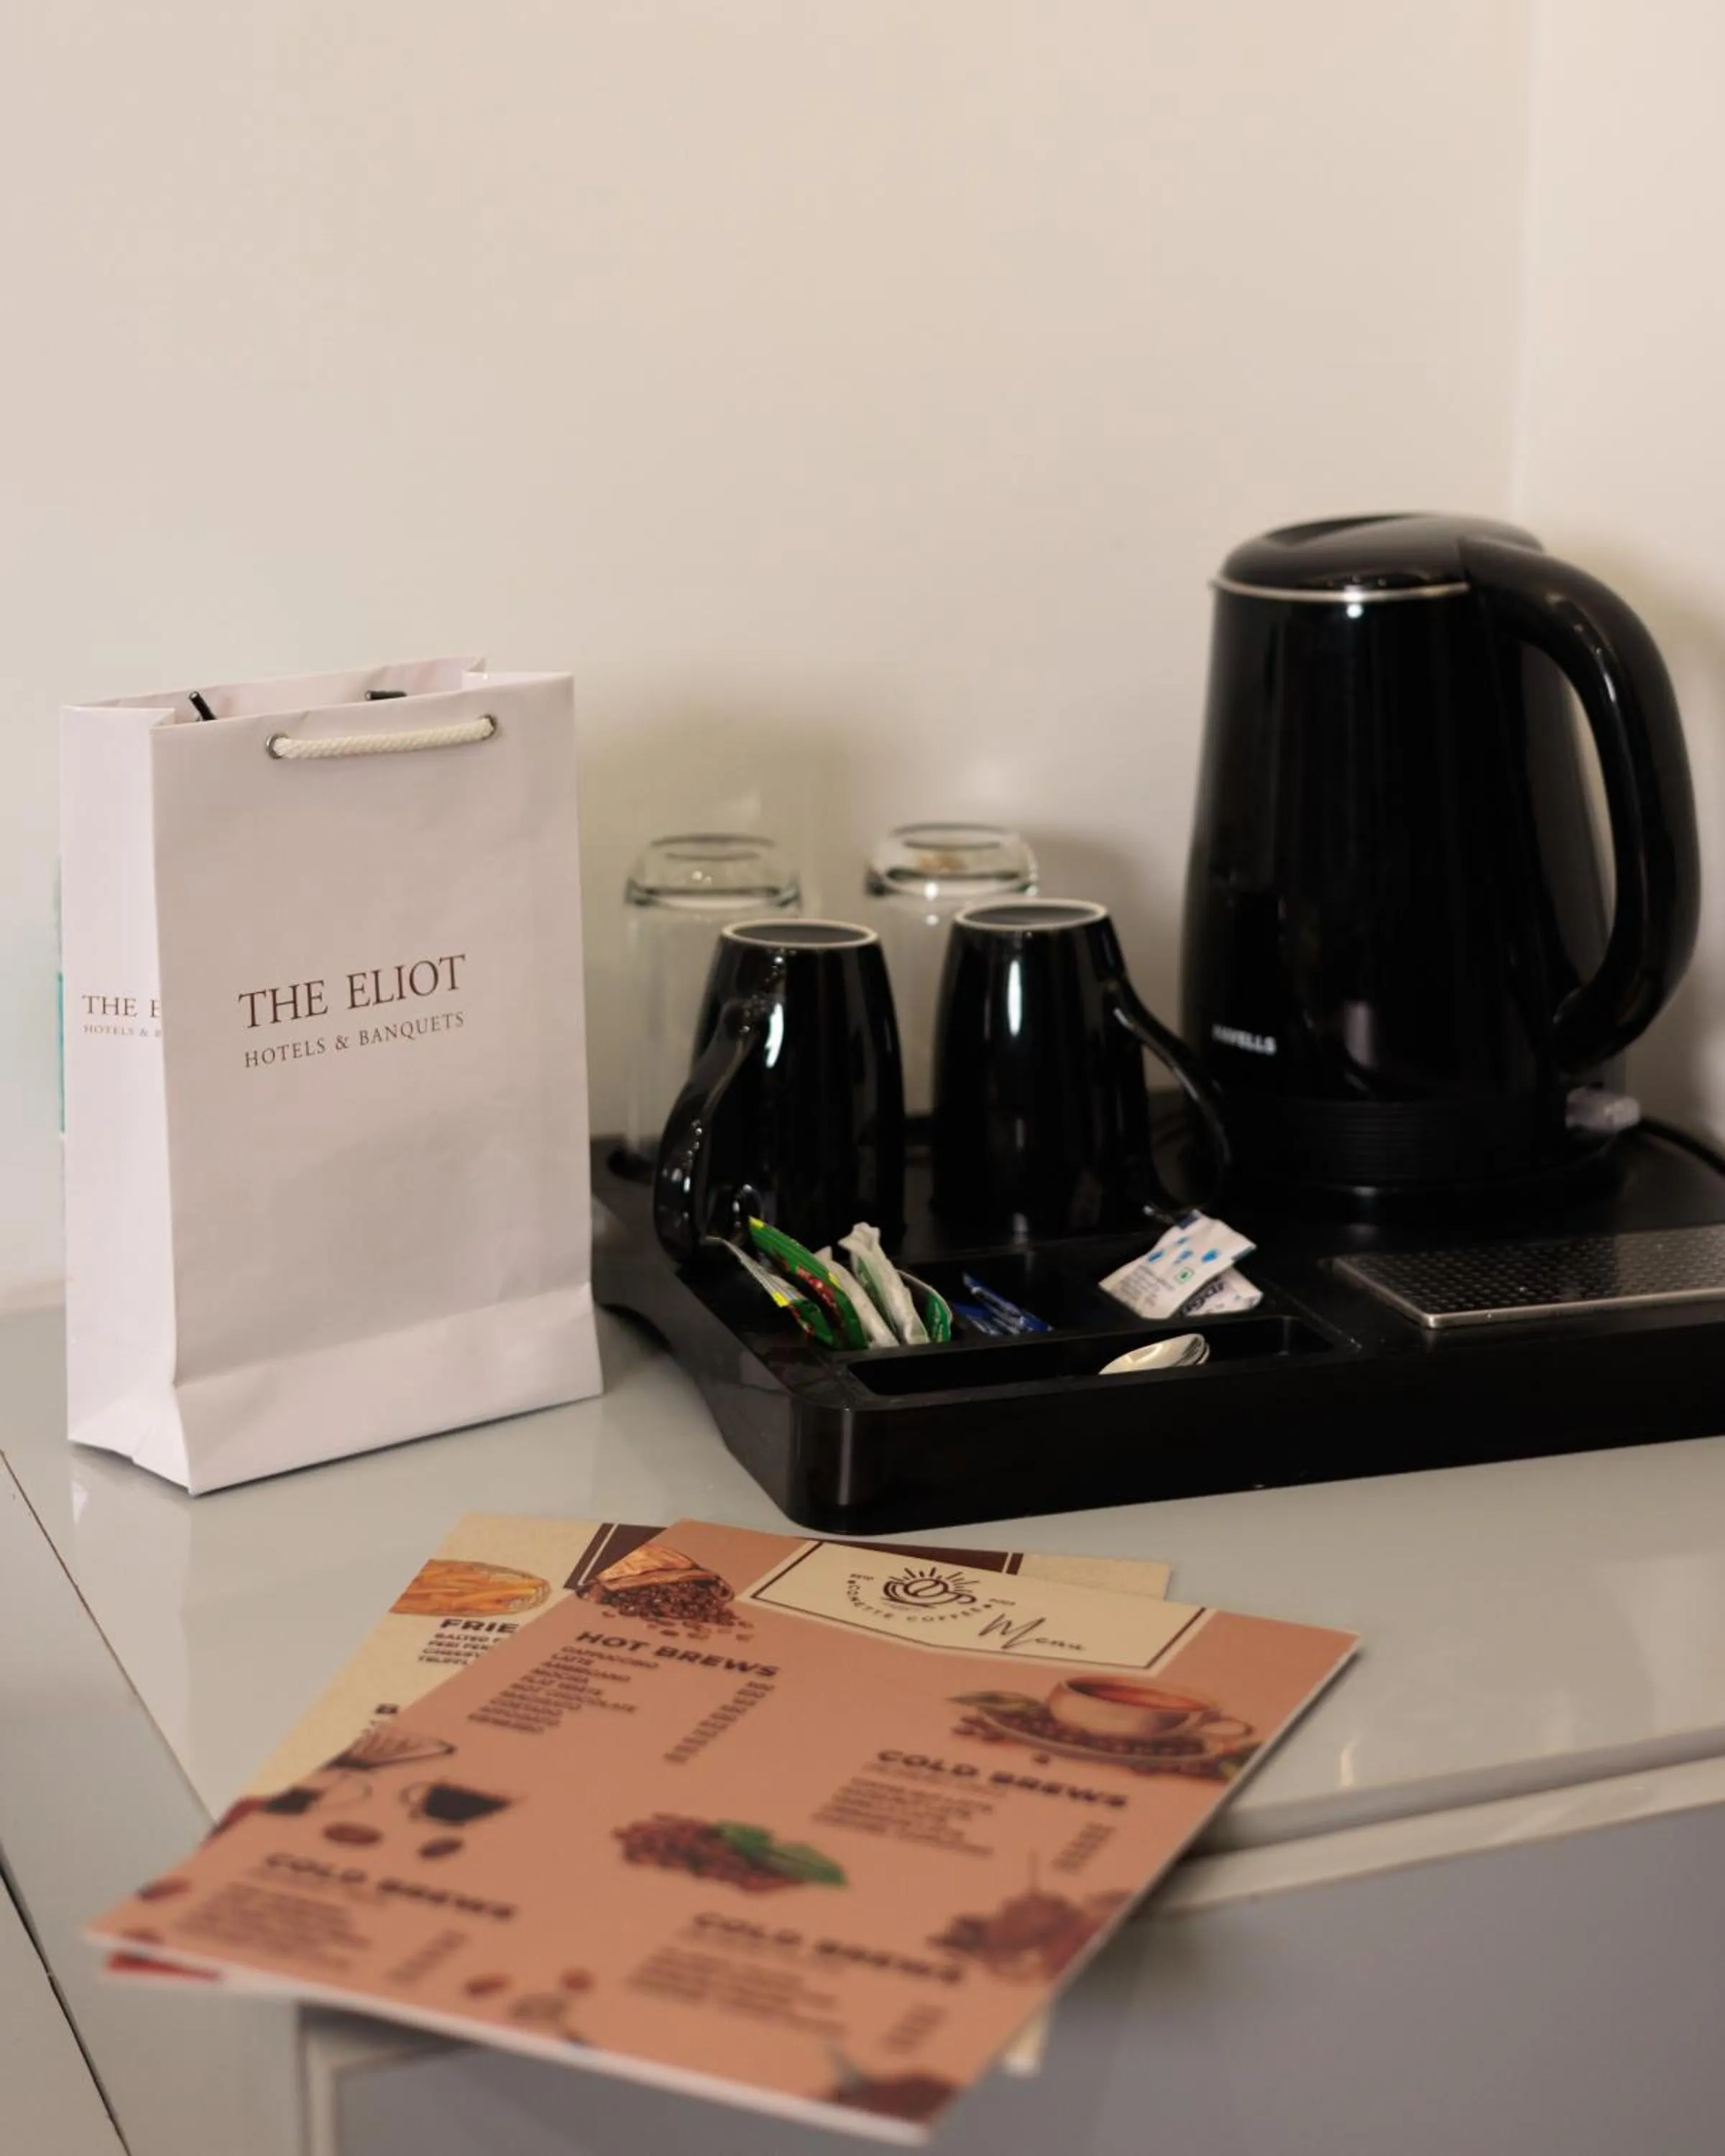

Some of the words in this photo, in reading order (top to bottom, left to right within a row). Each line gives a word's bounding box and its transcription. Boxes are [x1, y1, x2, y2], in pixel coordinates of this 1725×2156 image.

[81, 995, 138, 1017] THE
[238, 979, 329, 1028] THE
[346, 954, 466, 1010] ELIOT
[83, 1024, 135, 1036] HOTELS
[244, 1038, 326, 1069] HOTELS
[335, 1033, 349, 1051] &
[359, 1010, 465, 1047] BANQUETS
[440, 1618, 520, 1634] FRIE
[576, 1631, 650, 1651] HOT
[656, 1646, 780, 1677] BREWS
